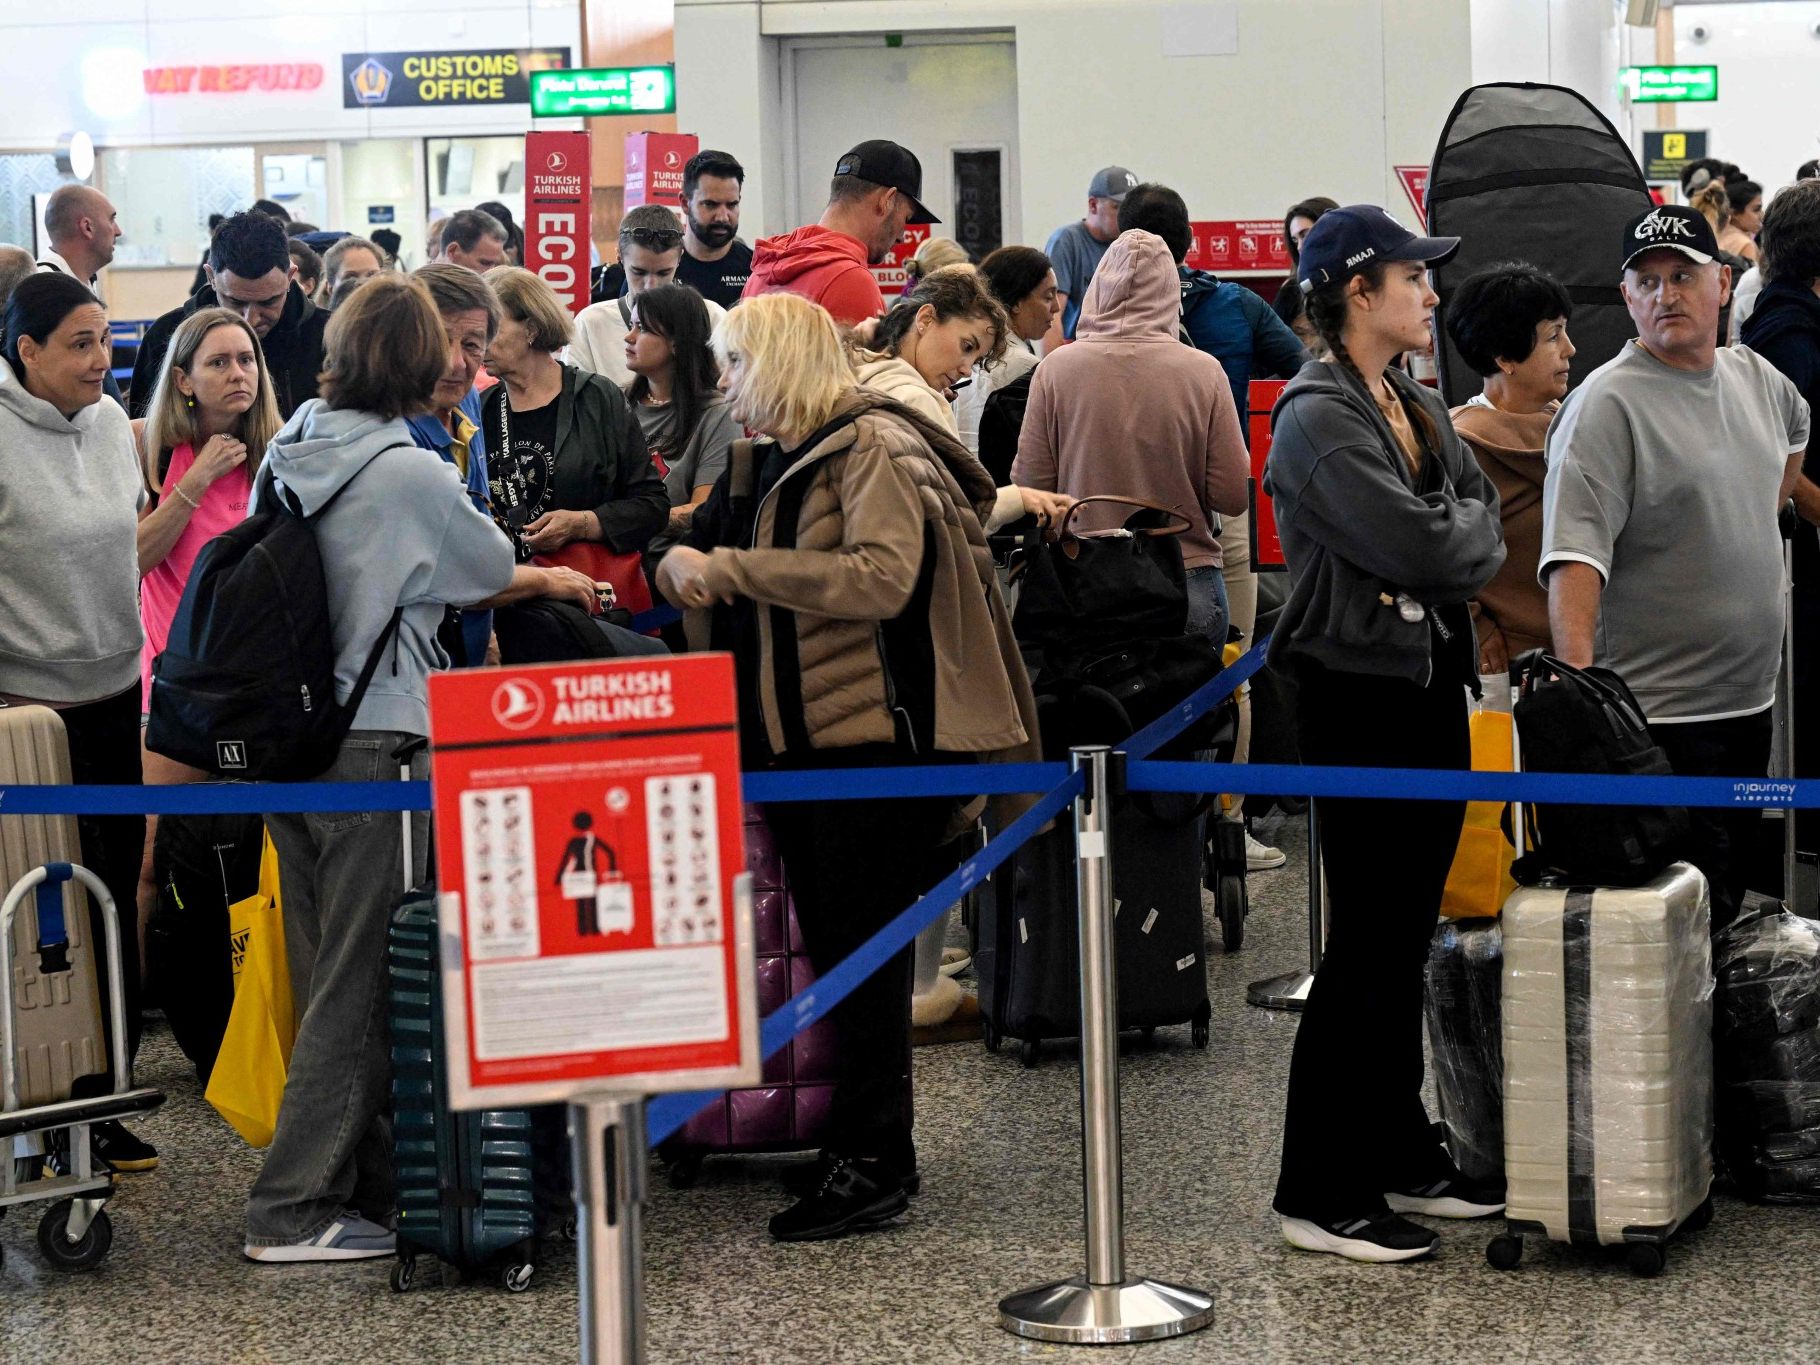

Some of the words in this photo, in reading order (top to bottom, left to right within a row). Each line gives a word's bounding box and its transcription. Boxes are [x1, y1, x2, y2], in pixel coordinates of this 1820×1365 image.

[403, 54, 519, 78] CUSTOMS
[143, 67, 197, 94] VAT
[199, 63, 324, 92] REFUND
[419, 78, 505, 101] OFFICE
[533, 175, 581, 185] TURKISH
[652, 180, 682, 190] AIRLIN
[653, 171, 684, 181] TURKIS
[533, 185, 581, 195] AIRLINES
[1634, 208, 1696, 240] GWK
[1345, 247, 1375, 269] ЯМАЛ
[877, 271, 909, 282] BLO
[500, 392, 509, 437] LAGERFELD
[502, 436, 510, 458] KARL
[534, 442, 545, 451] DE
[552, 670, 672, 700] TURKISH
[552, 694, 675, 725] AIRLINES
